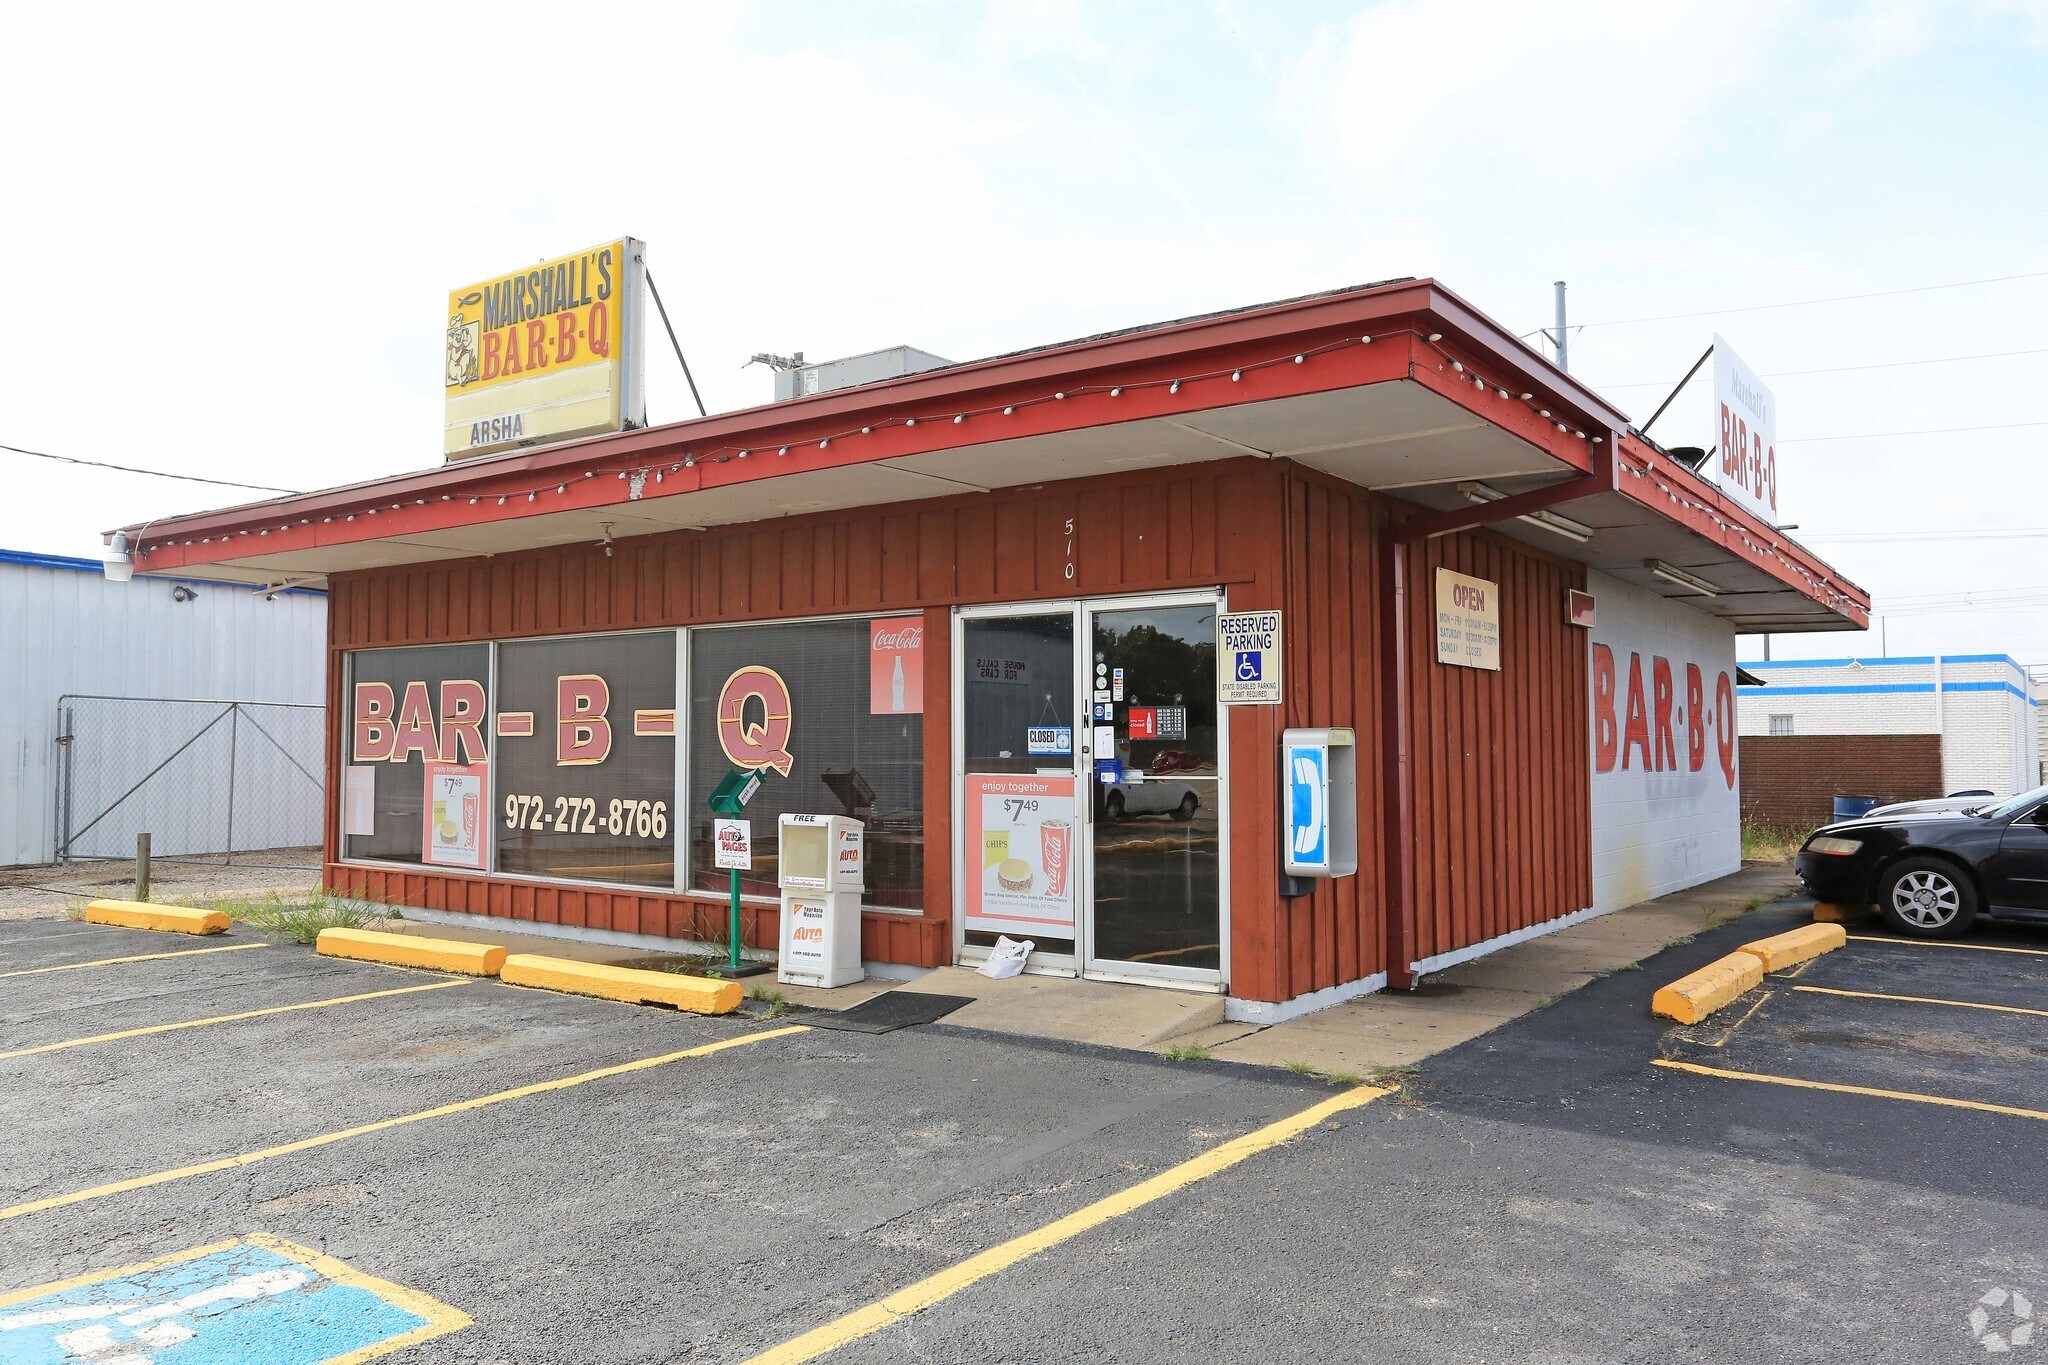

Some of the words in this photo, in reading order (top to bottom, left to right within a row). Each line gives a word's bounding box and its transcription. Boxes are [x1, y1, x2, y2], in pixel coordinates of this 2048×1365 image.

[483, 248, 613, 332] MARSHALL'S
[470, 413, 523, 445] ARSHA
[1064, 518, 1074, 579] 510
[1453, 583, 1485, 612] OPEN
[1221, 616, 1277, 634] RESERVED
[873, 627, 923, 650] Coca-Cola
[1440, 627, 1462, 639] SATURDAY
[1226, 633, 1271, 650] PARKING
[1440, 642, 1458, 653] SUNDAY
[1466, 645, 1482, 657] CLOSED
[1237, 682, 1256, 690] DISABLED
[1030, 730, 1055, 742] CLOSED
[433, 766, 446, 774] enjoy
[982, 781, 1006, 792] enjoy
[1008, 781, 1048, 792] together
[505, 794, 667, 839] 972-272-8766
[722, 841, 747, 852] PAGES
[986, 840, 1008, 848] CHIPS
[793, 927, 823, 940] AUTO
